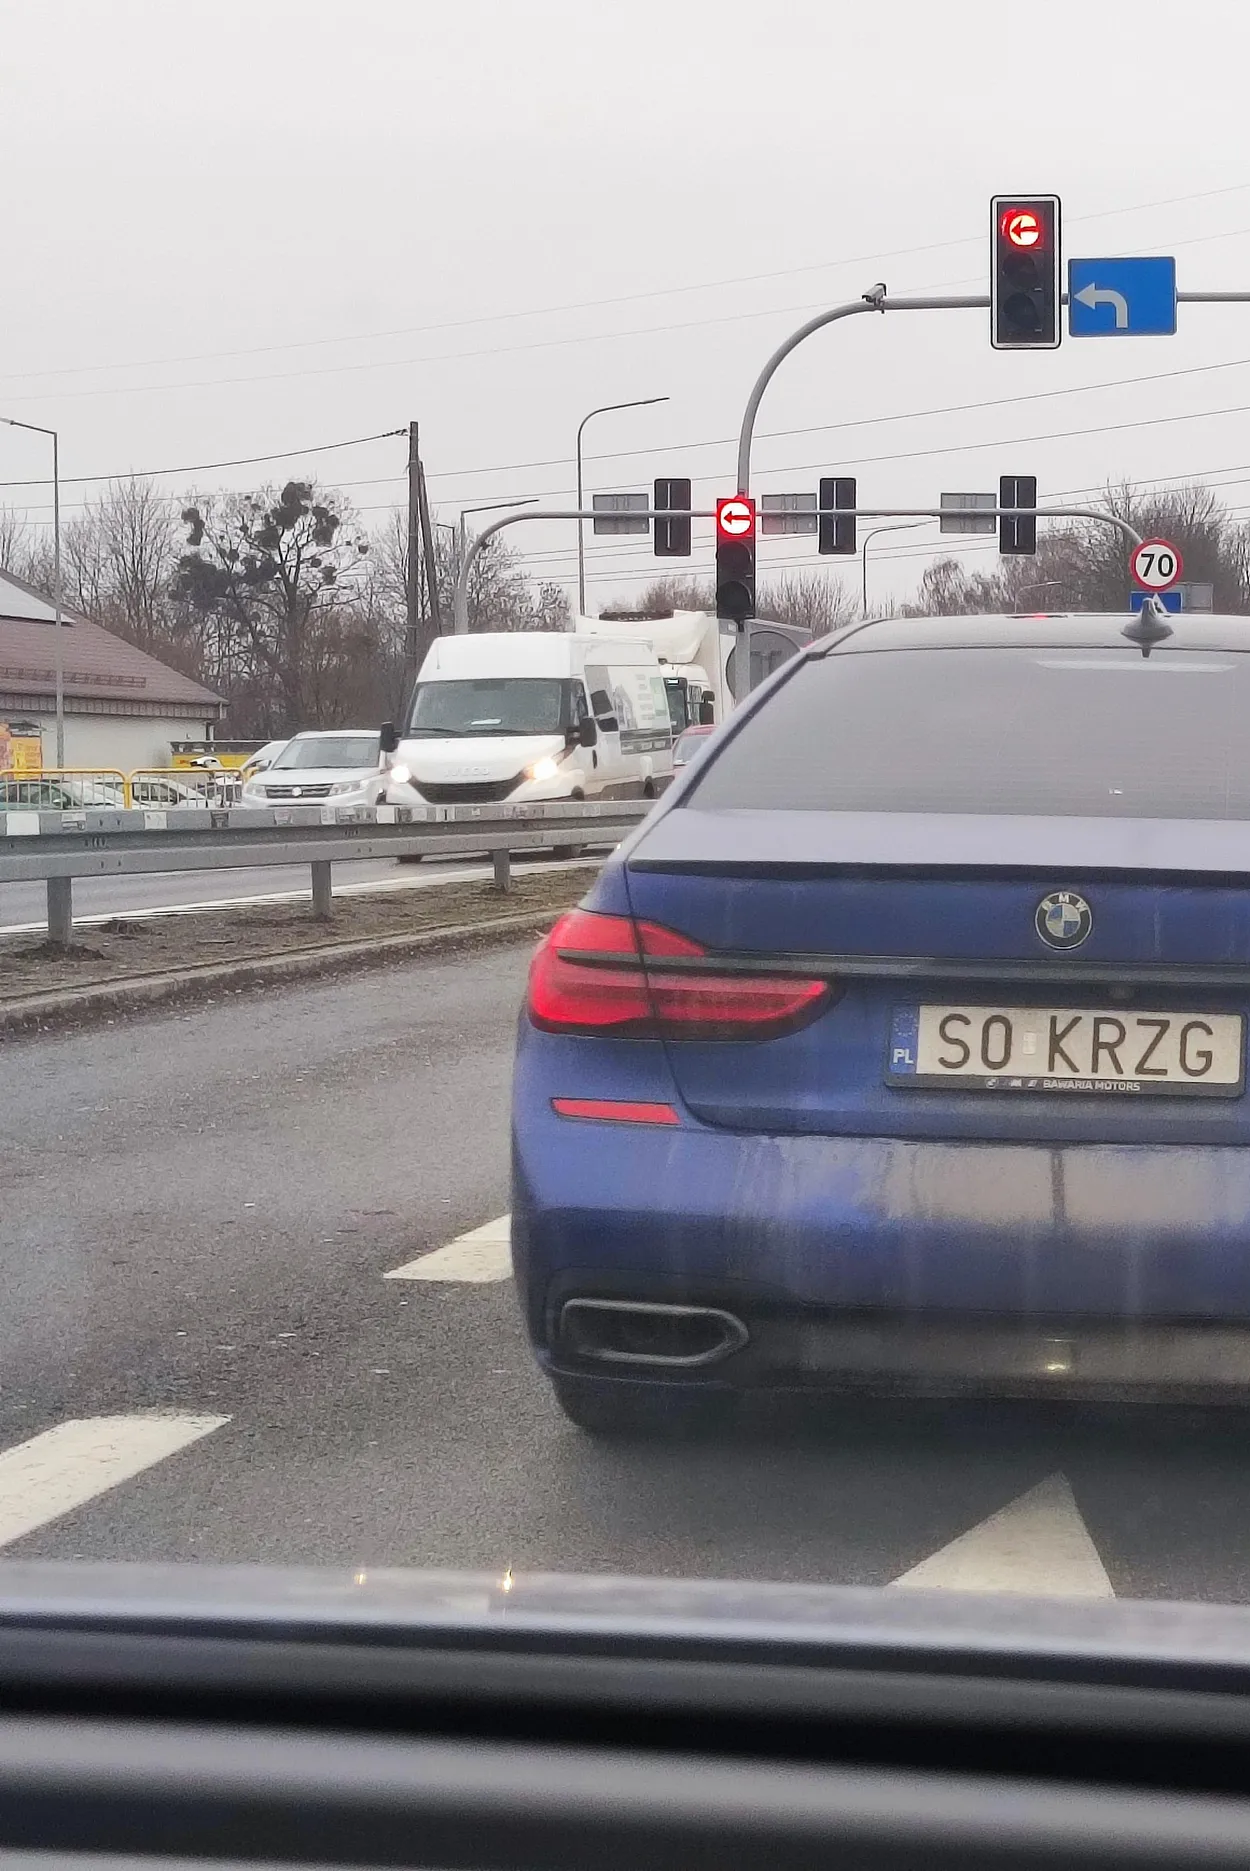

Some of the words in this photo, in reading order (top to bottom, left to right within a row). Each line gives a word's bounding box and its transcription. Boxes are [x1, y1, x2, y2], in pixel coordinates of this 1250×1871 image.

[1141, 553, 1174, 578] 70
[1041, 892, 1089, 912] BMW
[937, 1012, 1013, 1070] SO
[1047, 1014, 1214, 1077] KRZG
[892, 1048, 914, 1065] PL
[1043, 1080, 1093, 1090] BAWARIA
[1095, 1081, 1141, 1091] MOTORS
